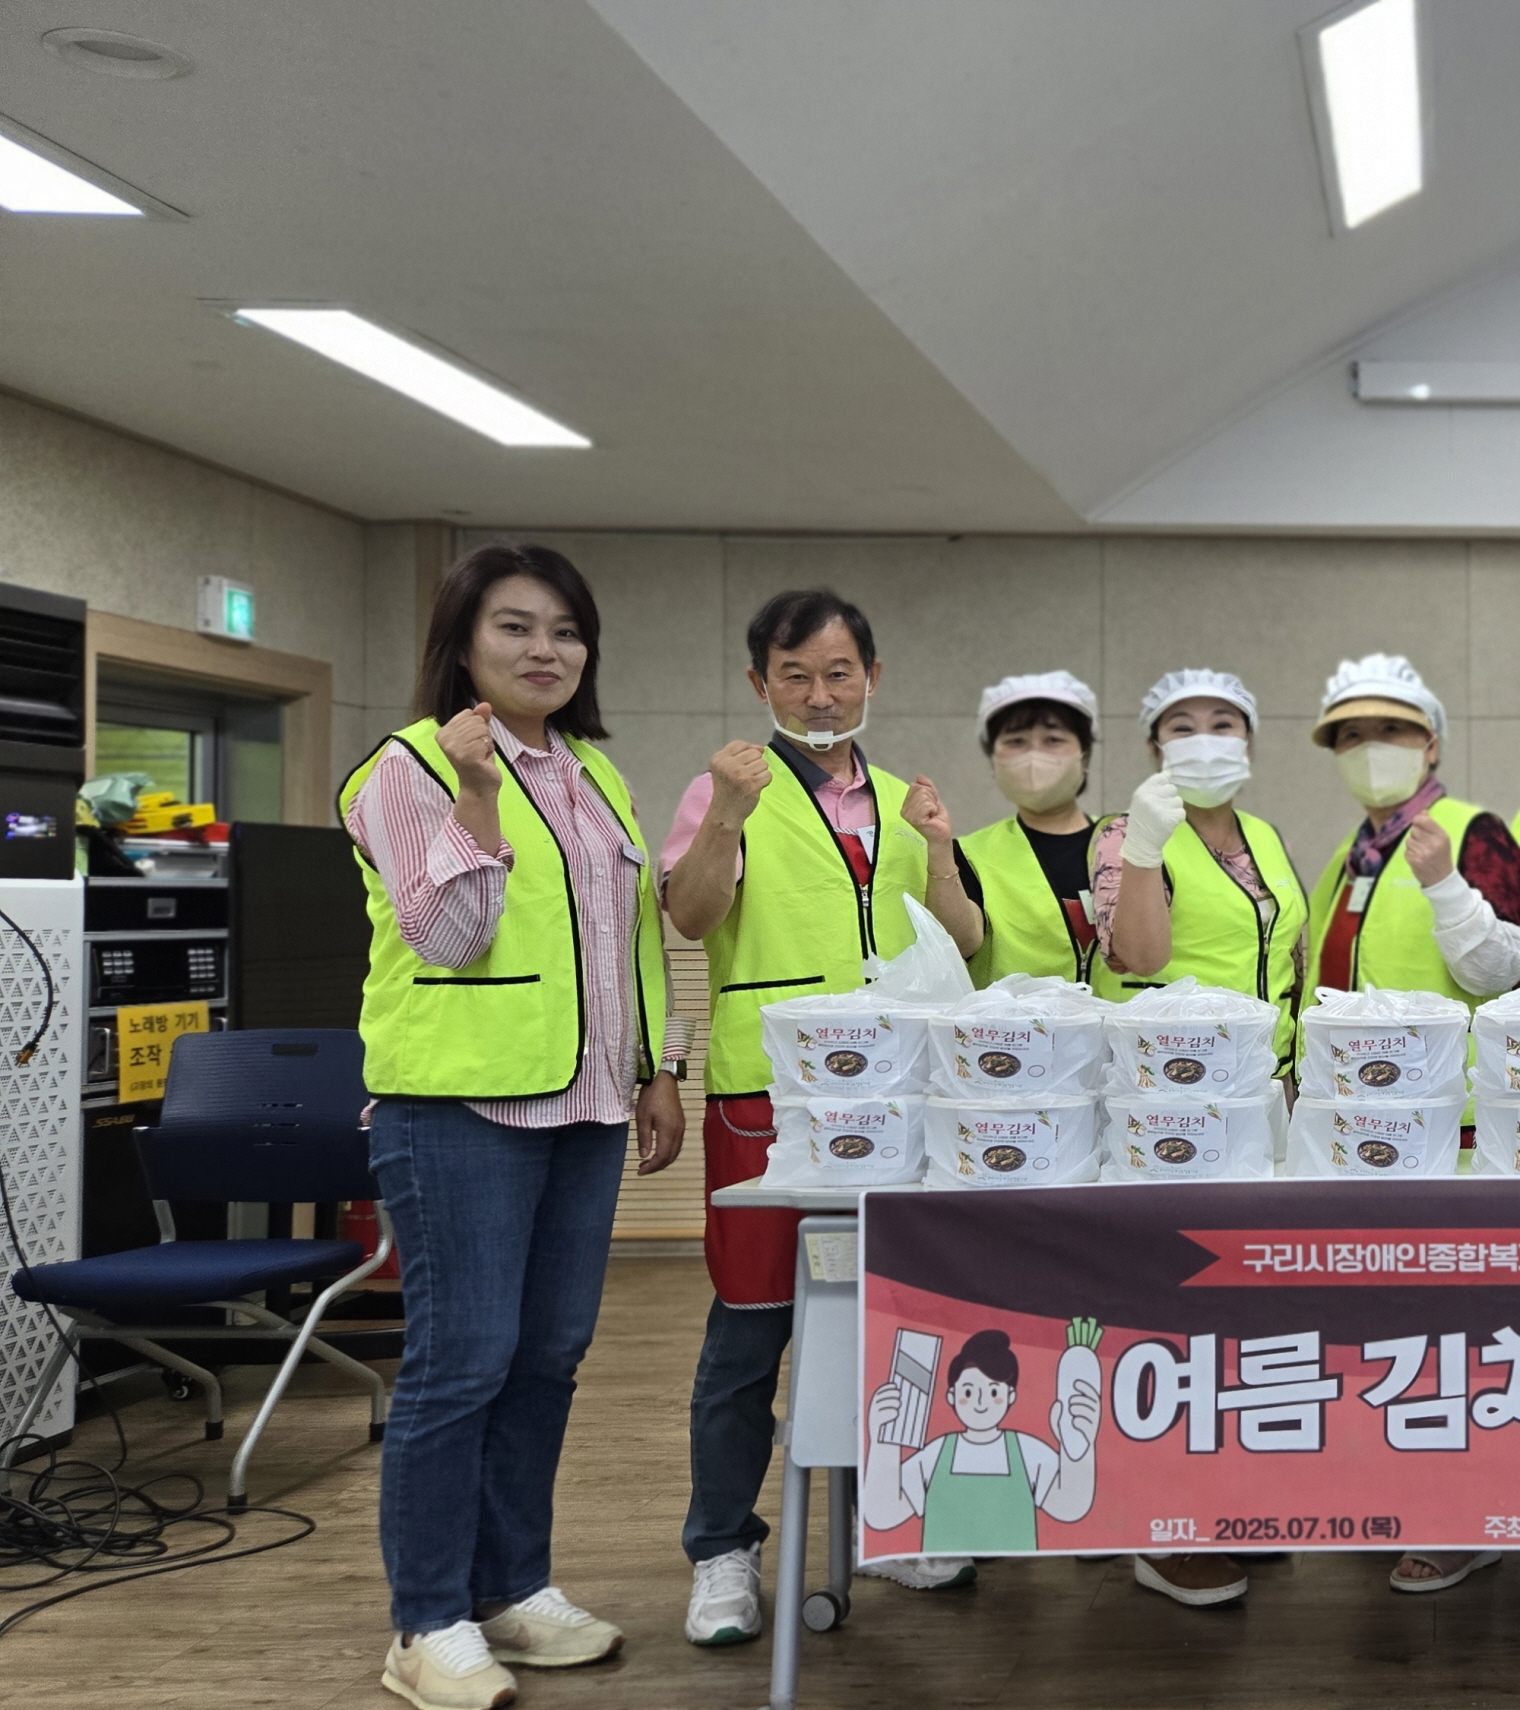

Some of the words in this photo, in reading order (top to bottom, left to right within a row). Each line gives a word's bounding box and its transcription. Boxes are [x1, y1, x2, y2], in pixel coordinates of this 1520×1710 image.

[129, 1014, 168, 1034] 노래방
[175, 1011, 199, 1031] 기기
[815, 1027, 877, 1040] 열무김치
[971, 1027, 1031, 1043] 열무김치
[1156, 1034, 1215, 1049] 열무김치
[1348, 1035, 1406, 1053] 열무김치
[129, 1044, 162, 1067] 조작
[824, 1111, 886, 1126] 열무김치
[1145, 1114, 1206, 1128] 열무김치
[1353, 1115, 1411, 1135] 열무김치
[974, 1121, 1036, 1136] 열무김치
[1111, 1330, 1343, 1455] 여름
[1214, 1516, 1356, 1541] 2025.07.10
[1360, 1516, 1403, 1541] (목)
